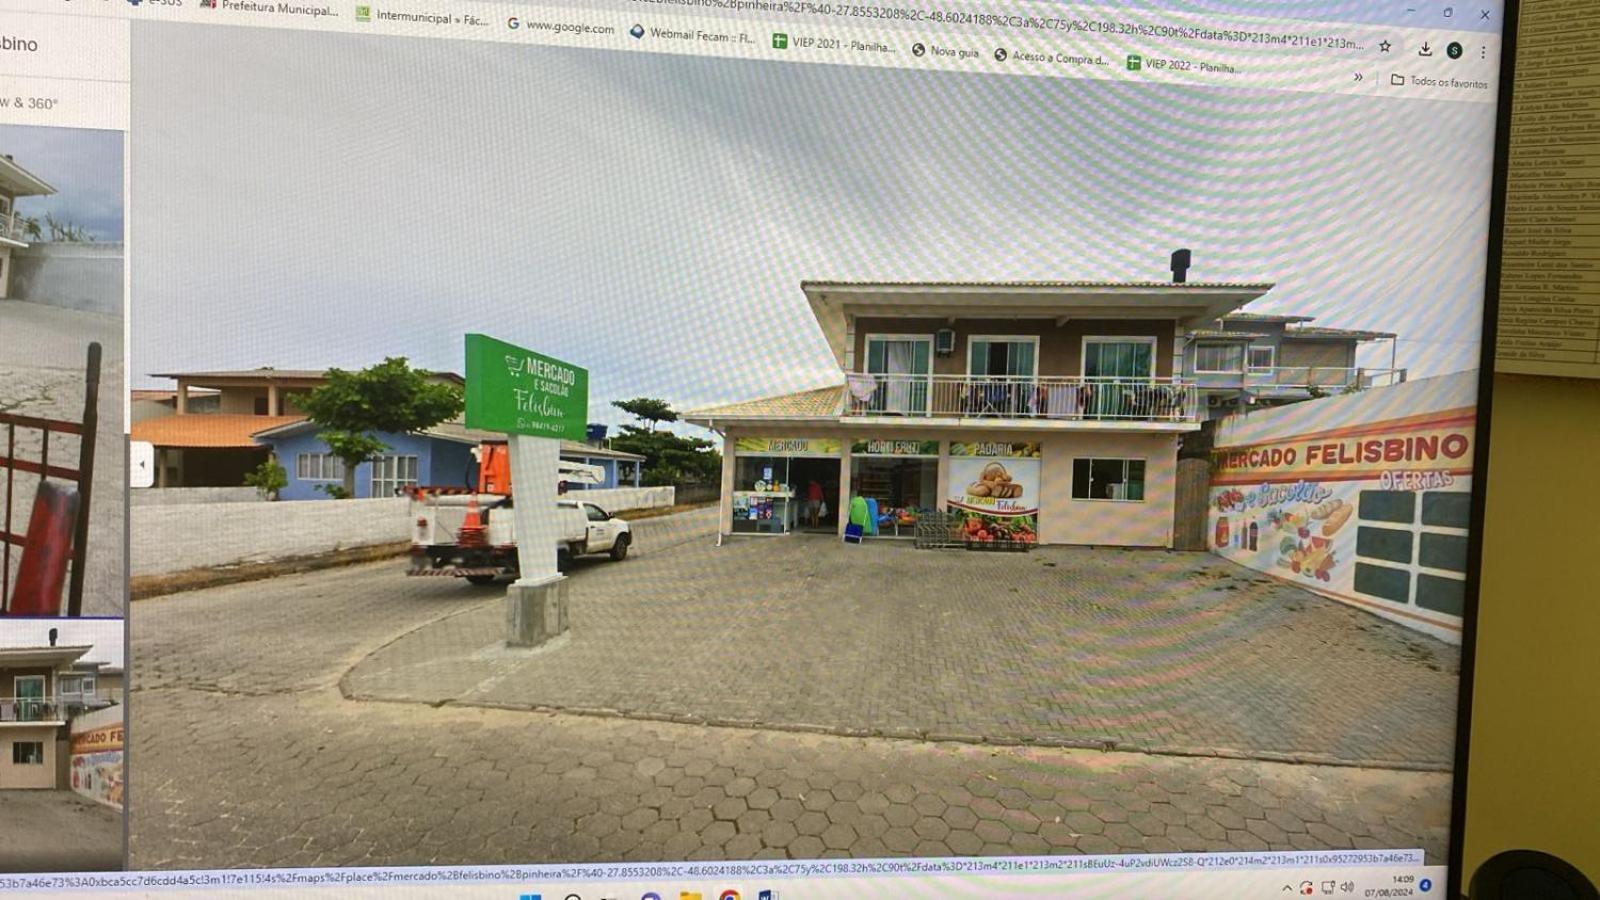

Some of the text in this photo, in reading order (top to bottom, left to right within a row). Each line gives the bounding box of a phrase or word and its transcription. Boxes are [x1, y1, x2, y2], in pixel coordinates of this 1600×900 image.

[222, 0, 275, 13] Prefeitura
[377, 9, 452, 25] Intermunicipal
[527, 20, 615, 36] www.google.com
[650, 28, 695, 40] Webmail
[698, 30, 729, 42] Fecam
[0, 35, 38, 52] bino
[793, 37, 815, 48] VIEP
[817, 39, 840, 49] 2021
[931, 45, 979, 60] Nova guia
[1013, 51, 1046, 62] Acesso
[1056, 53, 1093, 67] Compra
[1146, 58, 1167, 69] VIEP
[1169, 59, 1191, 70] 2022
[1411, 75, 1488, 89] Todos os favoritos
[14, 97, 23, 108] &
[527, 357, 575, 386] MERCADO
[534, 379, 540, 390] E
[975, 442, 1013, 456] PADARIA
[1217, 433, 1469, 470] MERCADO FELISBINO
[1380, 470, 1455, 491] OFERTAS
[1393, 875, 1415, 884] 14:09
[1365, 888, 1414, 898] 07/08/2024
